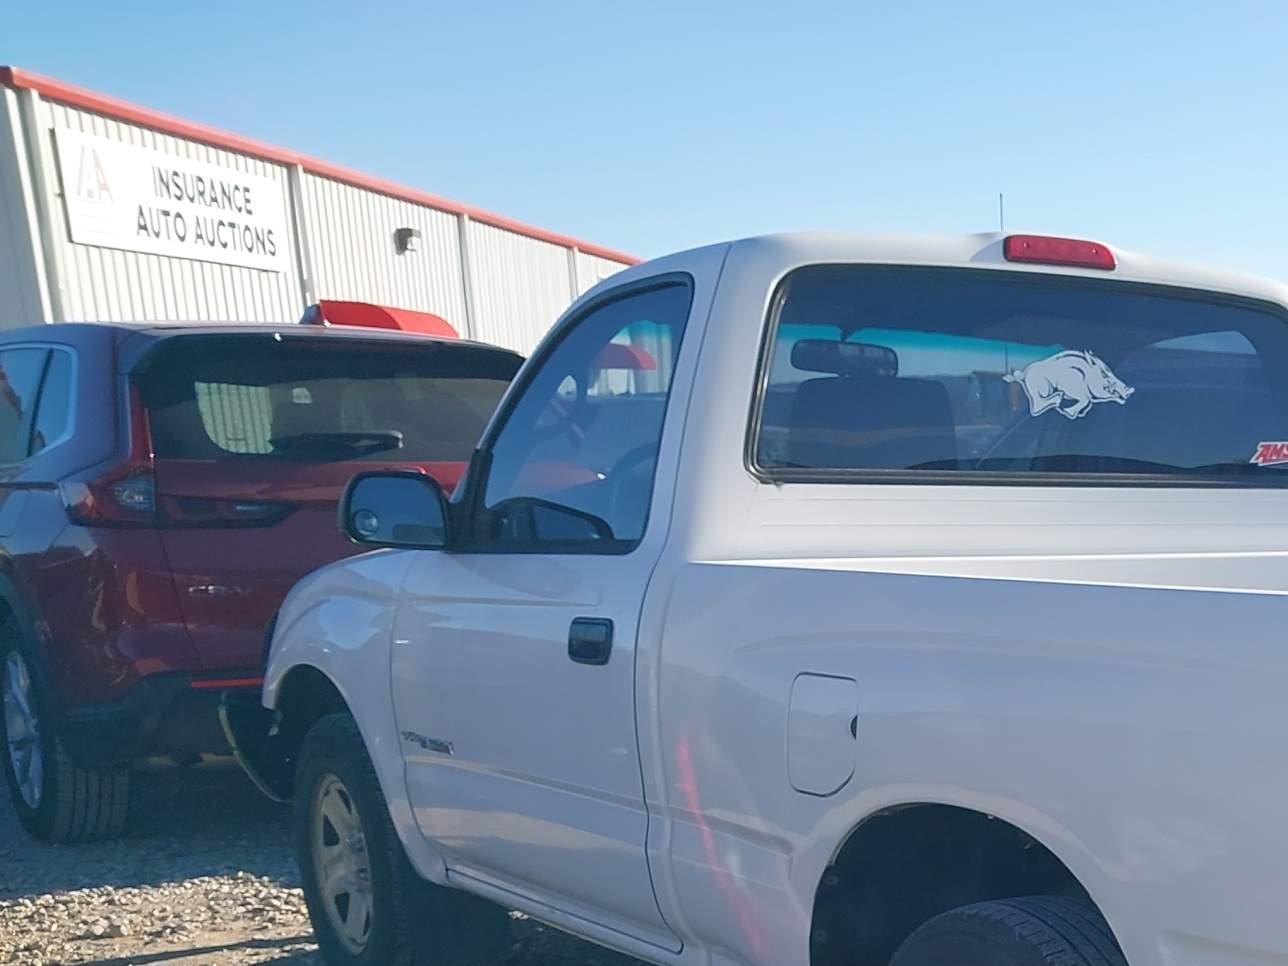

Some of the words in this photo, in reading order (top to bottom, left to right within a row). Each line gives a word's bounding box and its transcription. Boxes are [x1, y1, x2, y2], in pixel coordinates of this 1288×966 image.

[152, 166, 253, 215] INSURANCE
[136, 204, 187, 242] AUTO
[194, 215, 277, 257] AUCTIONS
